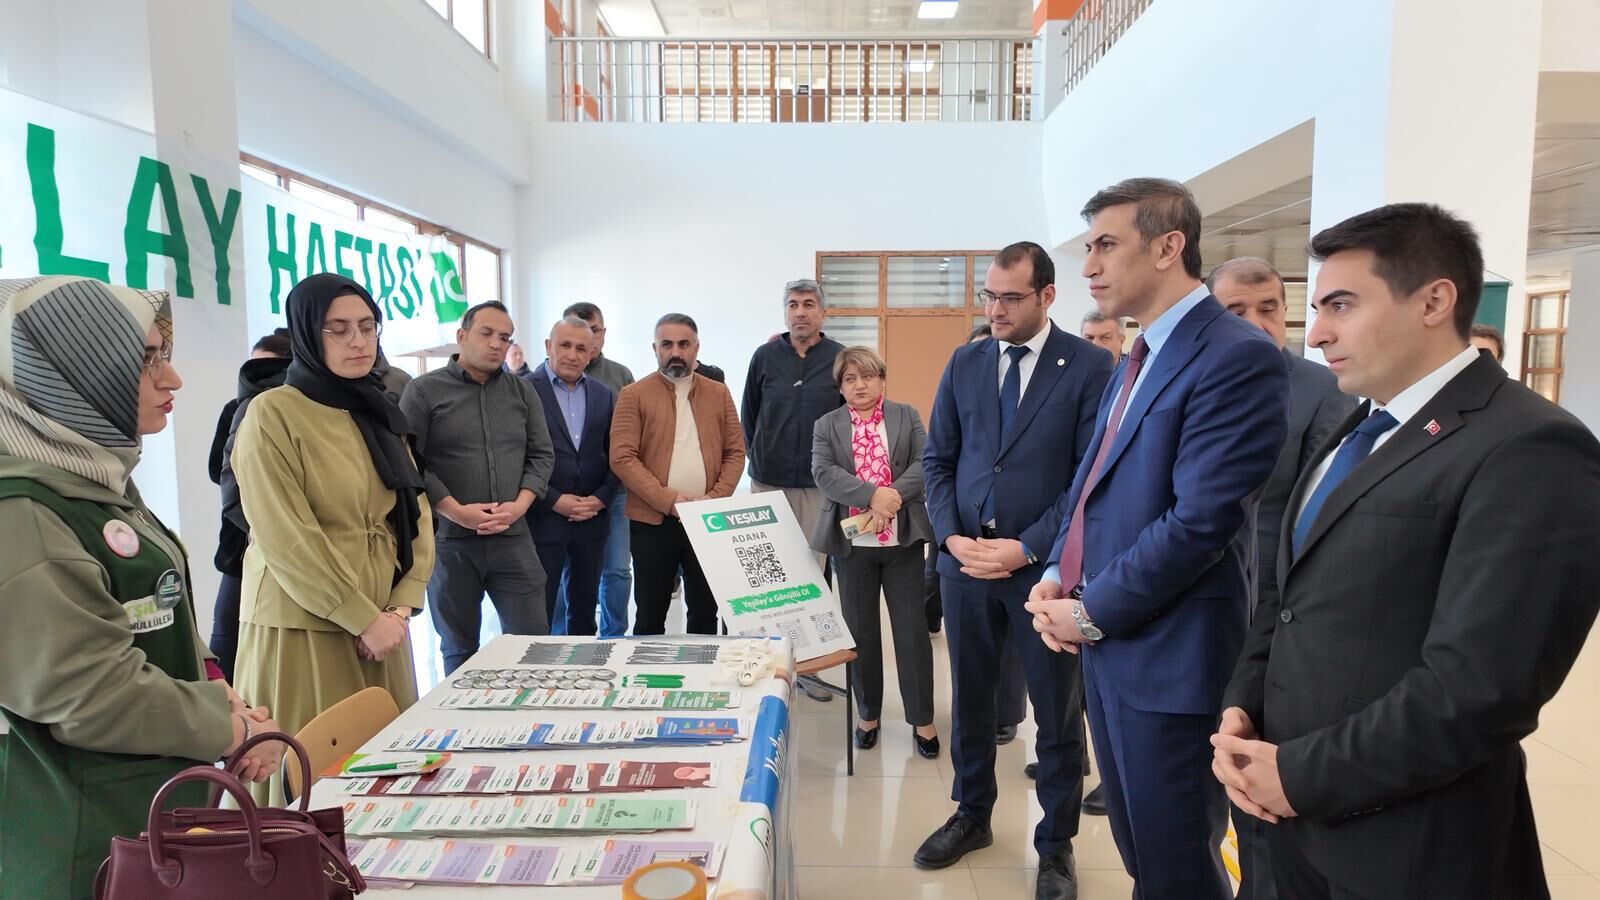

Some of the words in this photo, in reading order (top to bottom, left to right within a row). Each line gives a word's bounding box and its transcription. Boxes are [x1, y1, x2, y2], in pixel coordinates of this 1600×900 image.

[0, 122, 242, 306] LAY
[731, 531, 768, 544] ADANA
[801, 588, 810, 597] Ol
